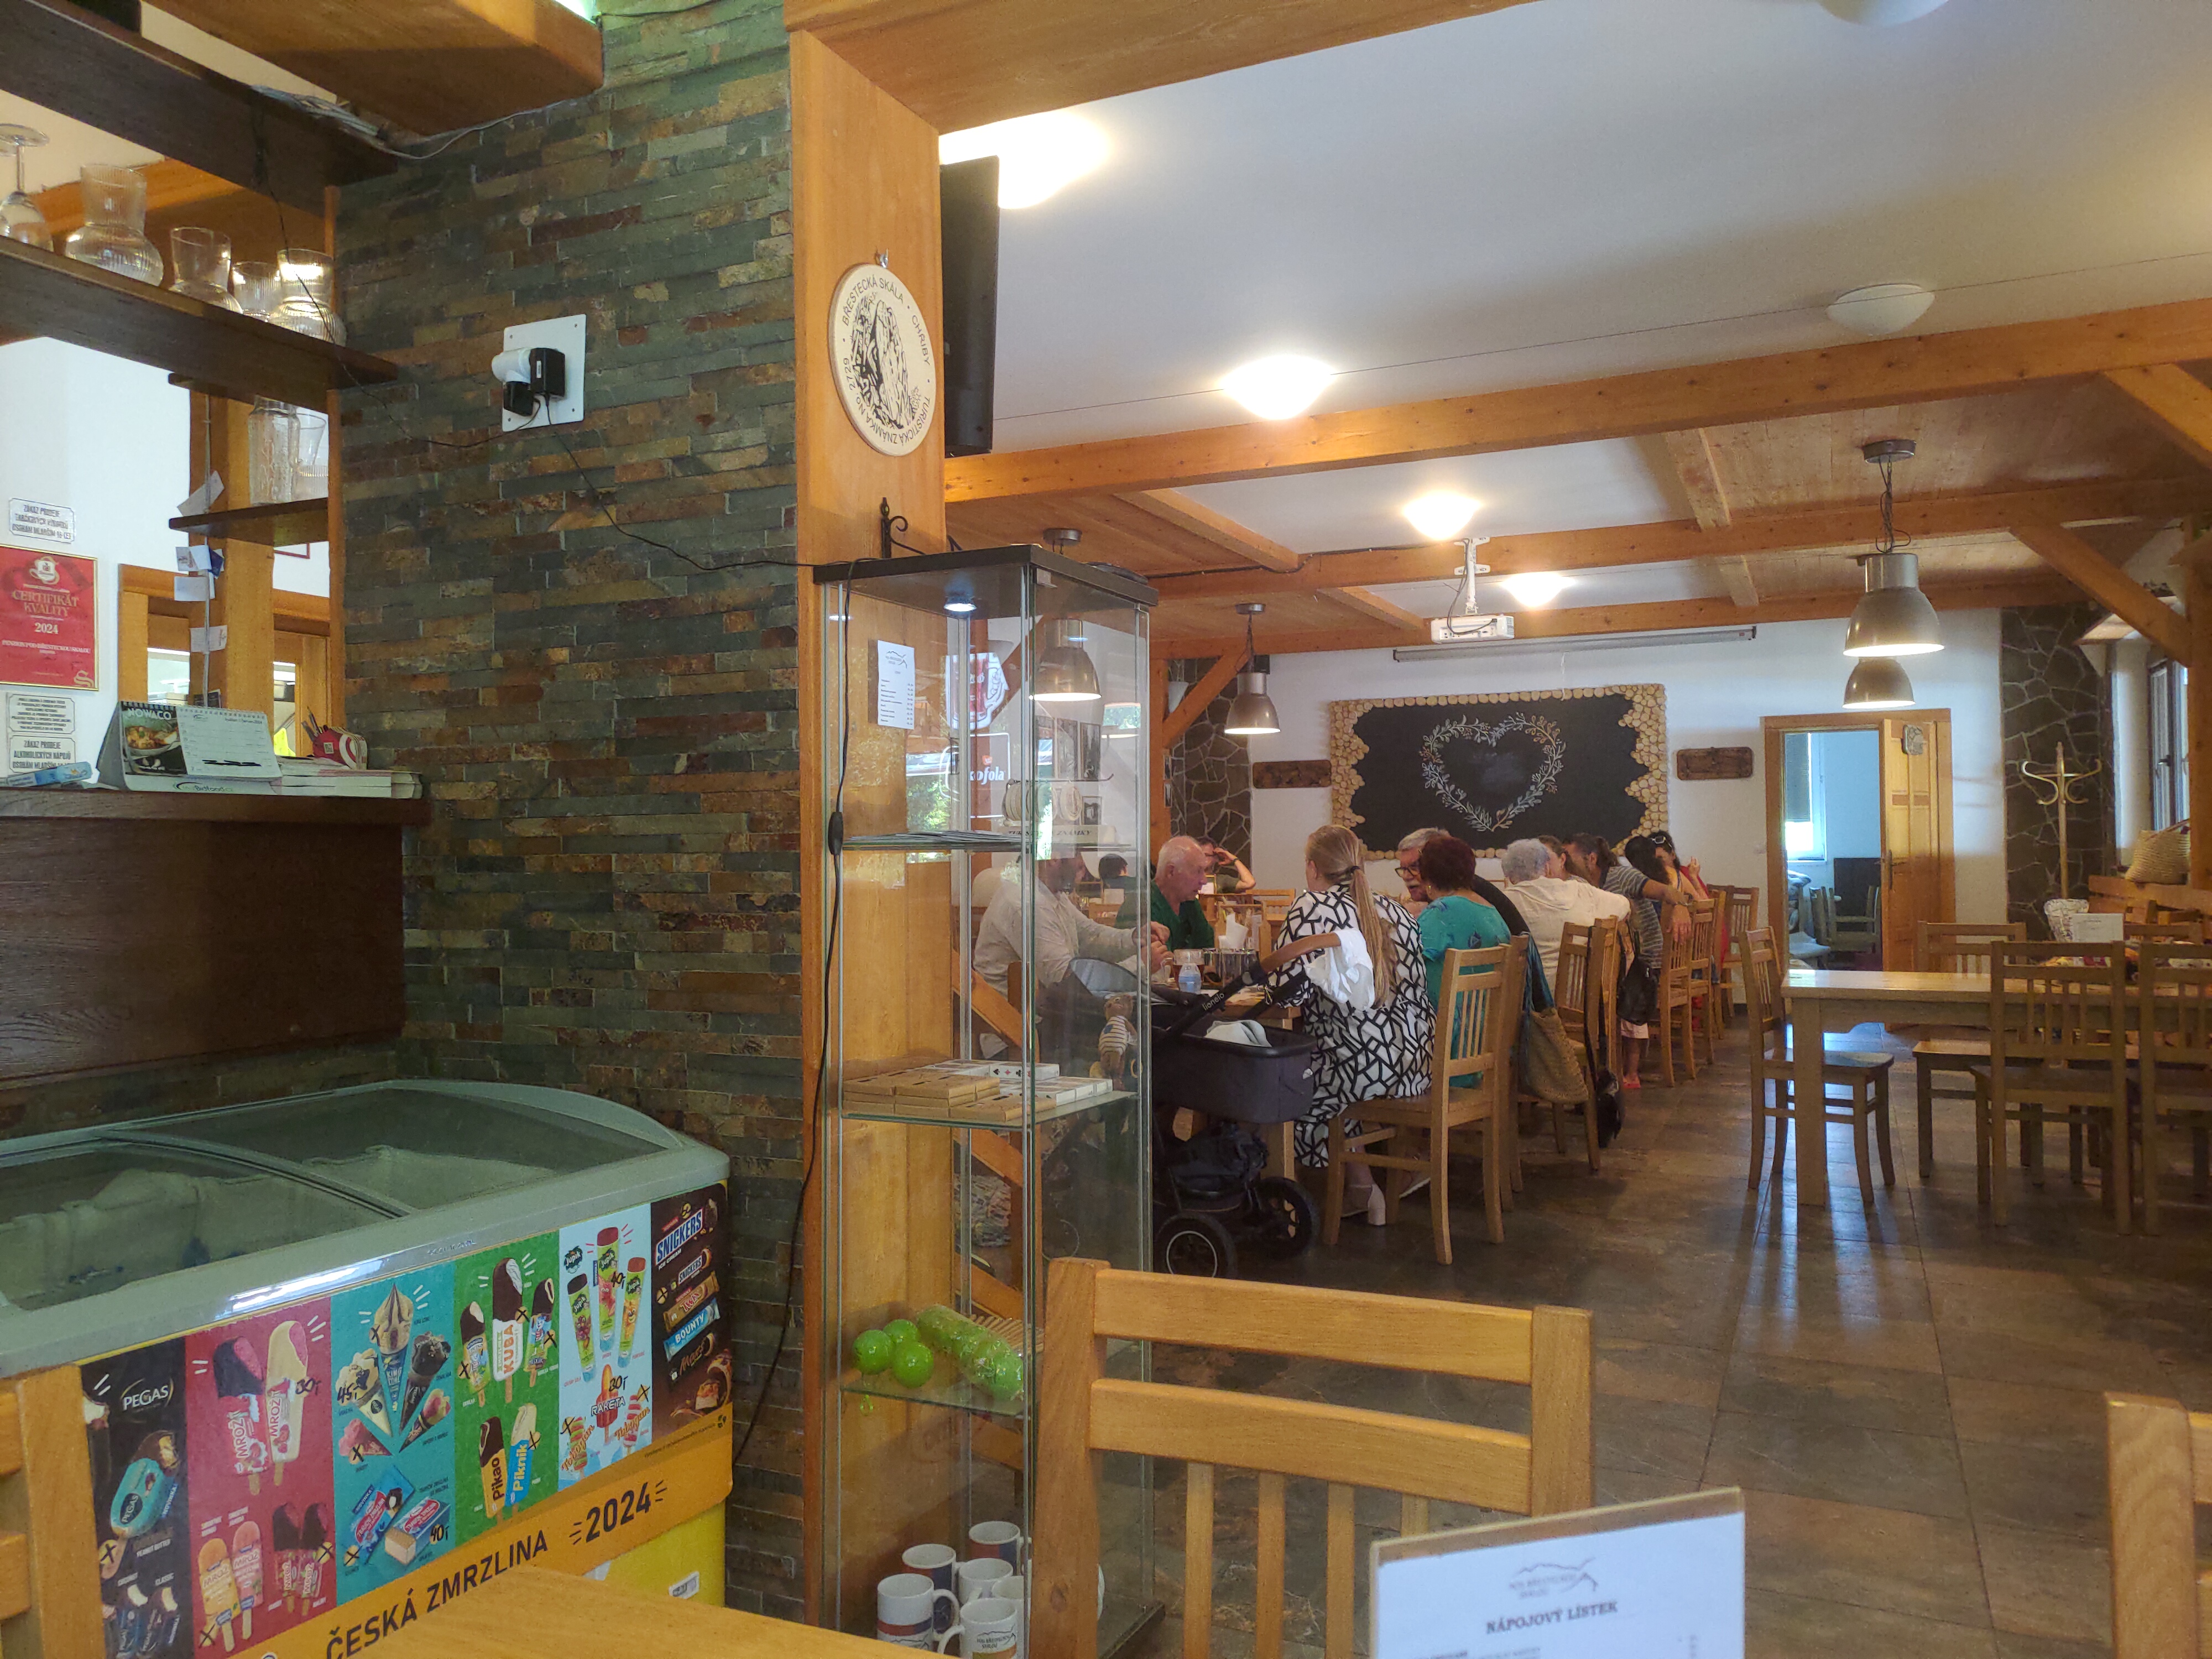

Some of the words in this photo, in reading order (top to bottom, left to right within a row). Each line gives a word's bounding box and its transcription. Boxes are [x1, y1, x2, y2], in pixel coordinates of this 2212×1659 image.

[879, 278, 904, 304] SKÁLA
[843, 358, 856, 390] 2729
[866, 413, 898, 444] ZNÁMKA
[899, 397, 930, 446] TURISTICKÁ
[12, 590, 79, 607] CERTIFIKÁT
[24, 602, 70, 617] KVALITY
[35, 622, 59, 634] 2024
[128, 708, 171, 721] NOWACO
[1202, 993, 1225, 1011] lionelo
[657, 1210, 702, 1264] SNICKERS
[565, 1251, 582, 1267] Jupik
[600, 1252, 615, 1268] Jupik
[679, 1258, 701, 1283] SNICKERS
[675, 1312, 705, 1344] BOUNTY
[503, 1324, 514, 1374] KUBA
[123, 1385, 169, 1411] PEGAS
[591, 1396, 625, 1417] RAKETA
[269, 1397, 283, 1438] MROŽ
[614, 1407, 650, 1441] Tobogan
[228, 1417, 249, 1458] MROŽ
[561, 1425, 595, 1471] Tobogan
[491, 1457, 505, 1501] Pikao
[513, 1443, 528, 1491] Piknik
[122, 1494, 138, 1524] PEGAS
[586, 1482, 652, 1543] 2024
[326, 1588, 418, 1659] ČESKÁ
[426, 1530, 549, 1613] ZMRZLINA
[1486, 1606, 1563, 1634] NÁPOJOVÝ
[1568, 1600, 1618, 1620] LÍSTEK
